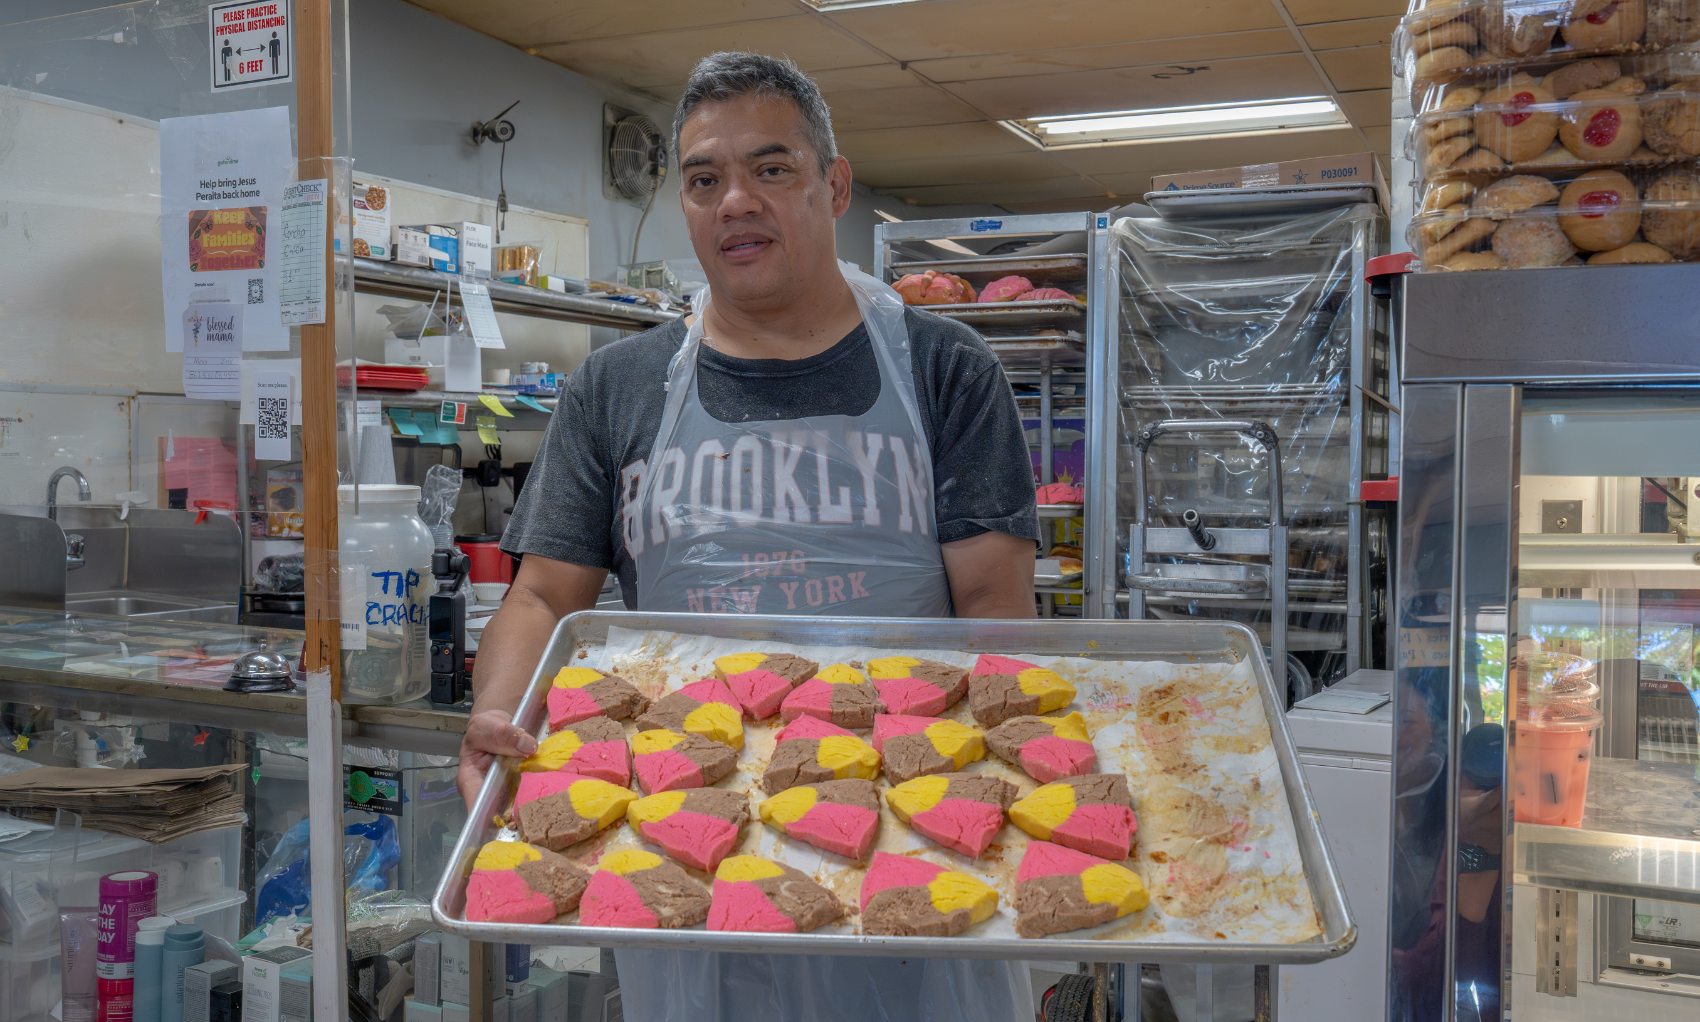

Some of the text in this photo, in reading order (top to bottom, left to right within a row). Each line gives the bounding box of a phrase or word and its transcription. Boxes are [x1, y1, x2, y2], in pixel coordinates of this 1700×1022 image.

[223, 4, 277, 23] PLEASE PRACTICE
[216, 15, 286, 36] PHYSICAL DISTANCING
[239, 59, 264, 75] 6 FEET
[1321, 166, 1358, 180] P030091
[200, 177, 257, 190] Help bring Jesus
[1207, 181, 1236, 189] Source
[196, 189, 260, 201] Peralta back home
[214, 210, 245, 225] Keep
[203, 230, 255, 247] Families
[466, 240, 477, 248] Face
[207, 315, 235, 332] blessed
[207, 333, 235, 342] mama
[621, 429, 929, 561] BROOKLYN
[741, 550, 806, 578] 1976
[371, 567, 420, 600] TIP
[685, 571, 870, 613] NEW YORK
